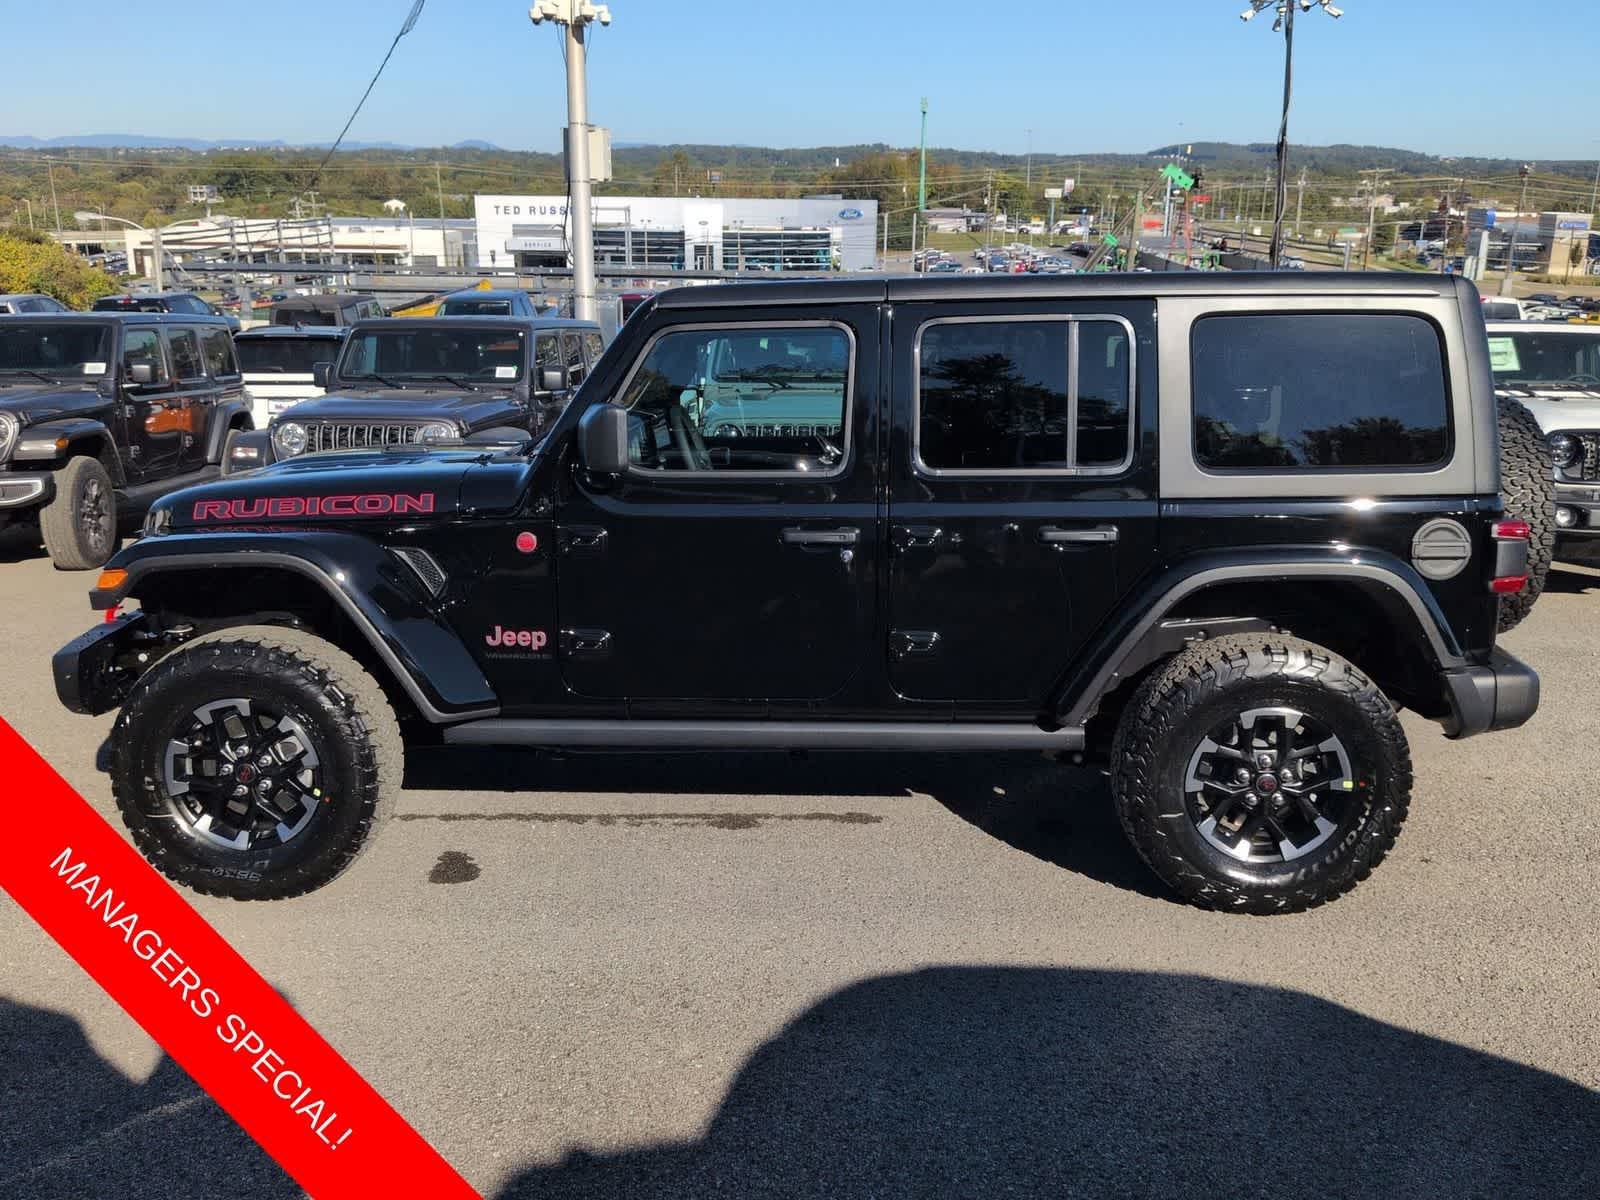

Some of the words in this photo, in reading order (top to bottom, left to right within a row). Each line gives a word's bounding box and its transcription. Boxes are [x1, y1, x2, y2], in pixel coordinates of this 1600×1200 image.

[494, 205, 521, 216] TED
[529, 205, 594, 216] RUSS
[193, 493, 434, 520] RUBICON
[485, 625, 547, 651] Jeep
